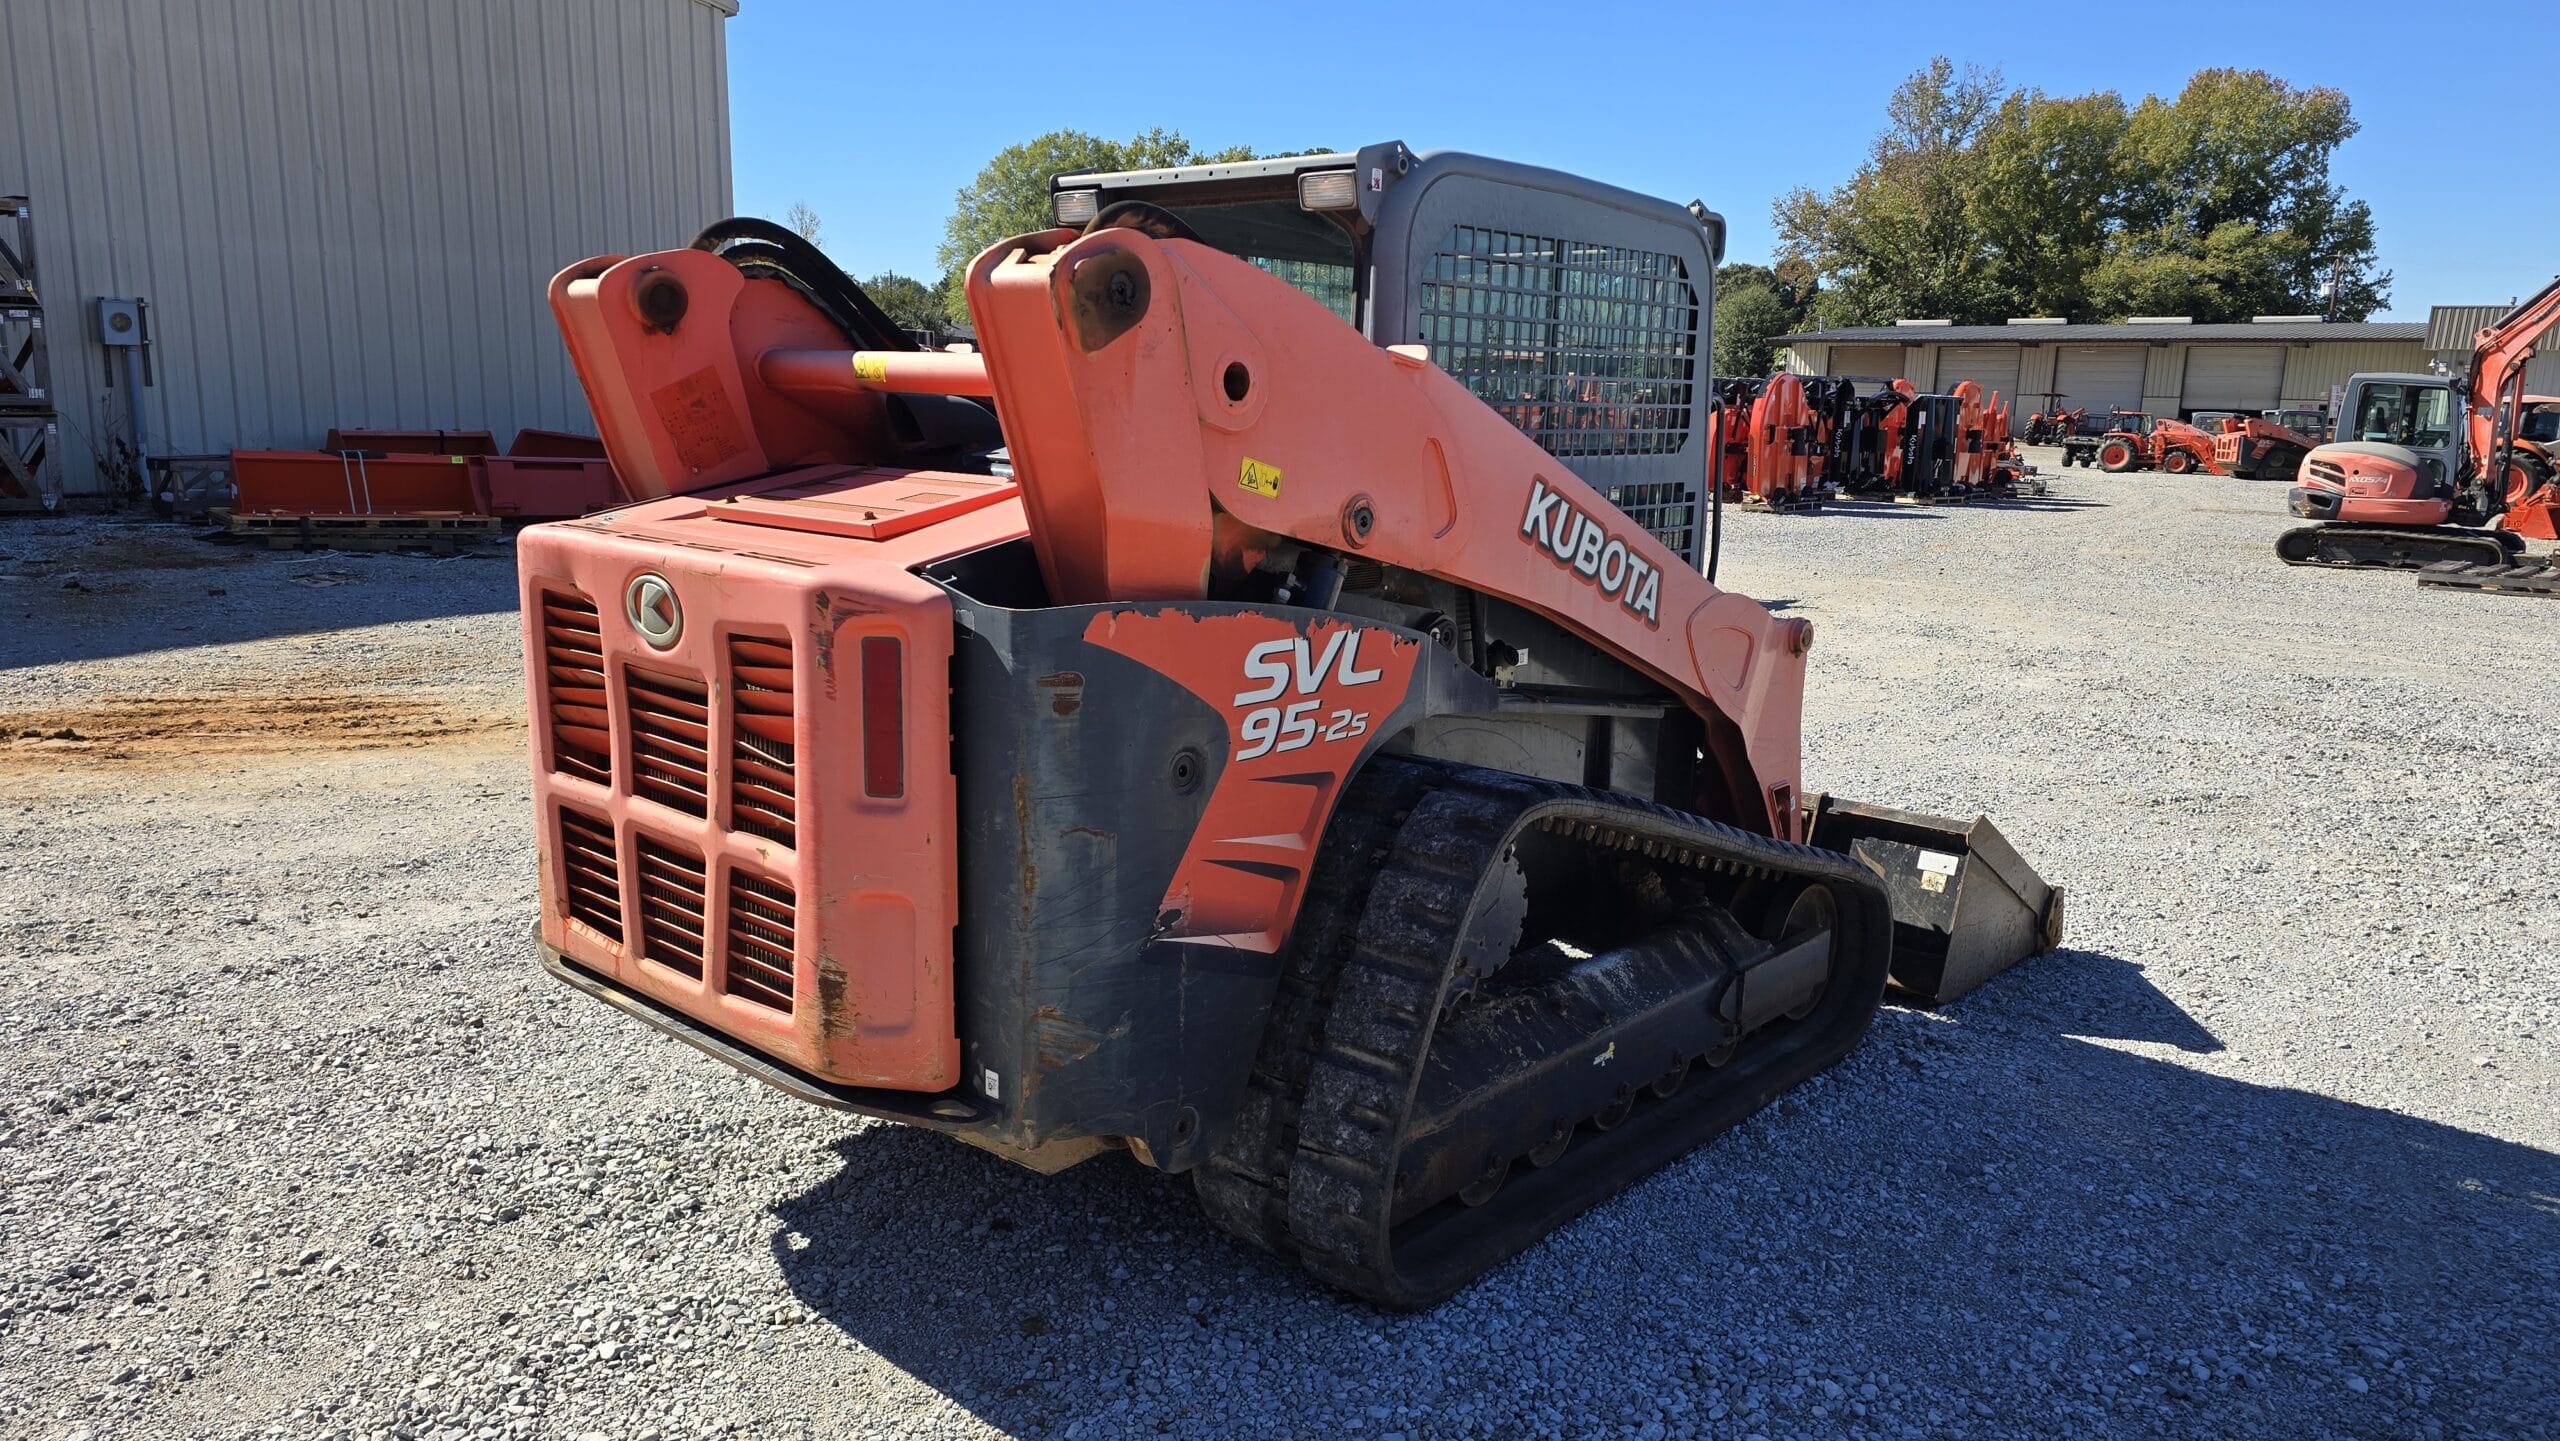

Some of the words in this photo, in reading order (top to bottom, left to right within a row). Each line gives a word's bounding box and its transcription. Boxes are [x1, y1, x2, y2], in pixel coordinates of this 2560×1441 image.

[1907, 434, 1917, 465] Kubota
[1522, 480, 1660, 624] KUBOTA
[1233, 627, 1383, 708] SVL
